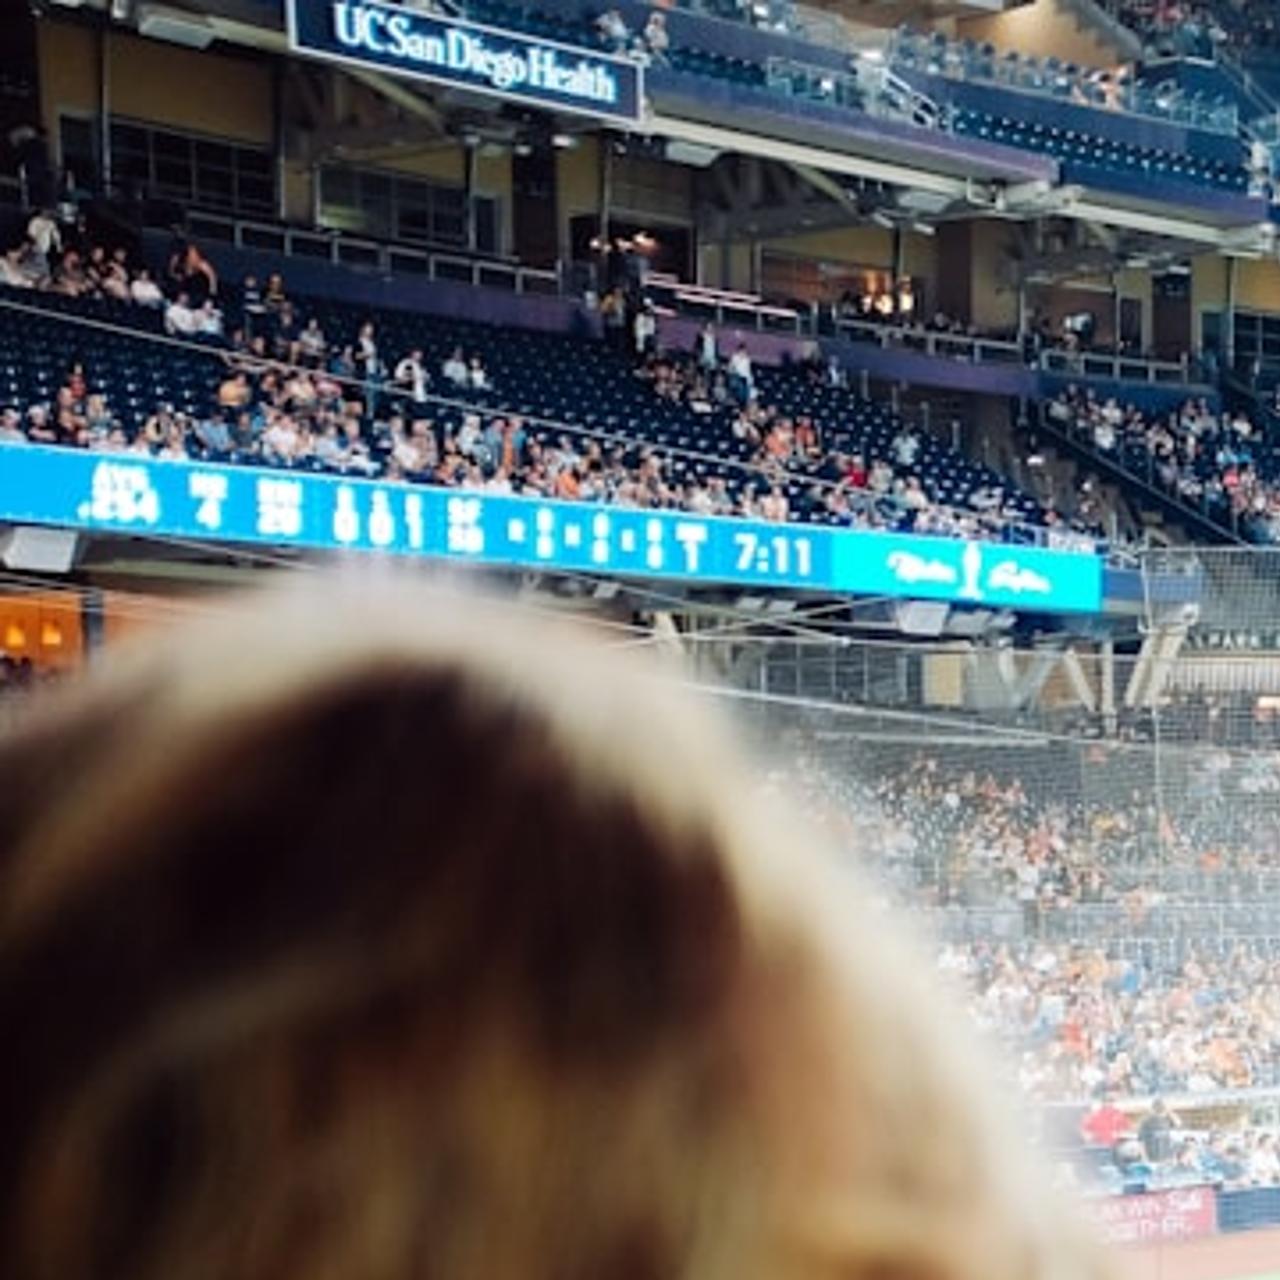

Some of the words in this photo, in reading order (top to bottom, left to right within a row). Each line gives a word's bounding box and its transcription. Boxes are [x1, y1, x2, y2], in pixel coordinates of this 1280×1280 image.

[333, 3, 386, 51] UC
[387, 17, 445, 65] San
[446, 28, 527, 90] Diego
[527, 45, 616, 102] Health
[737, 535, 809, 573] 7:11
